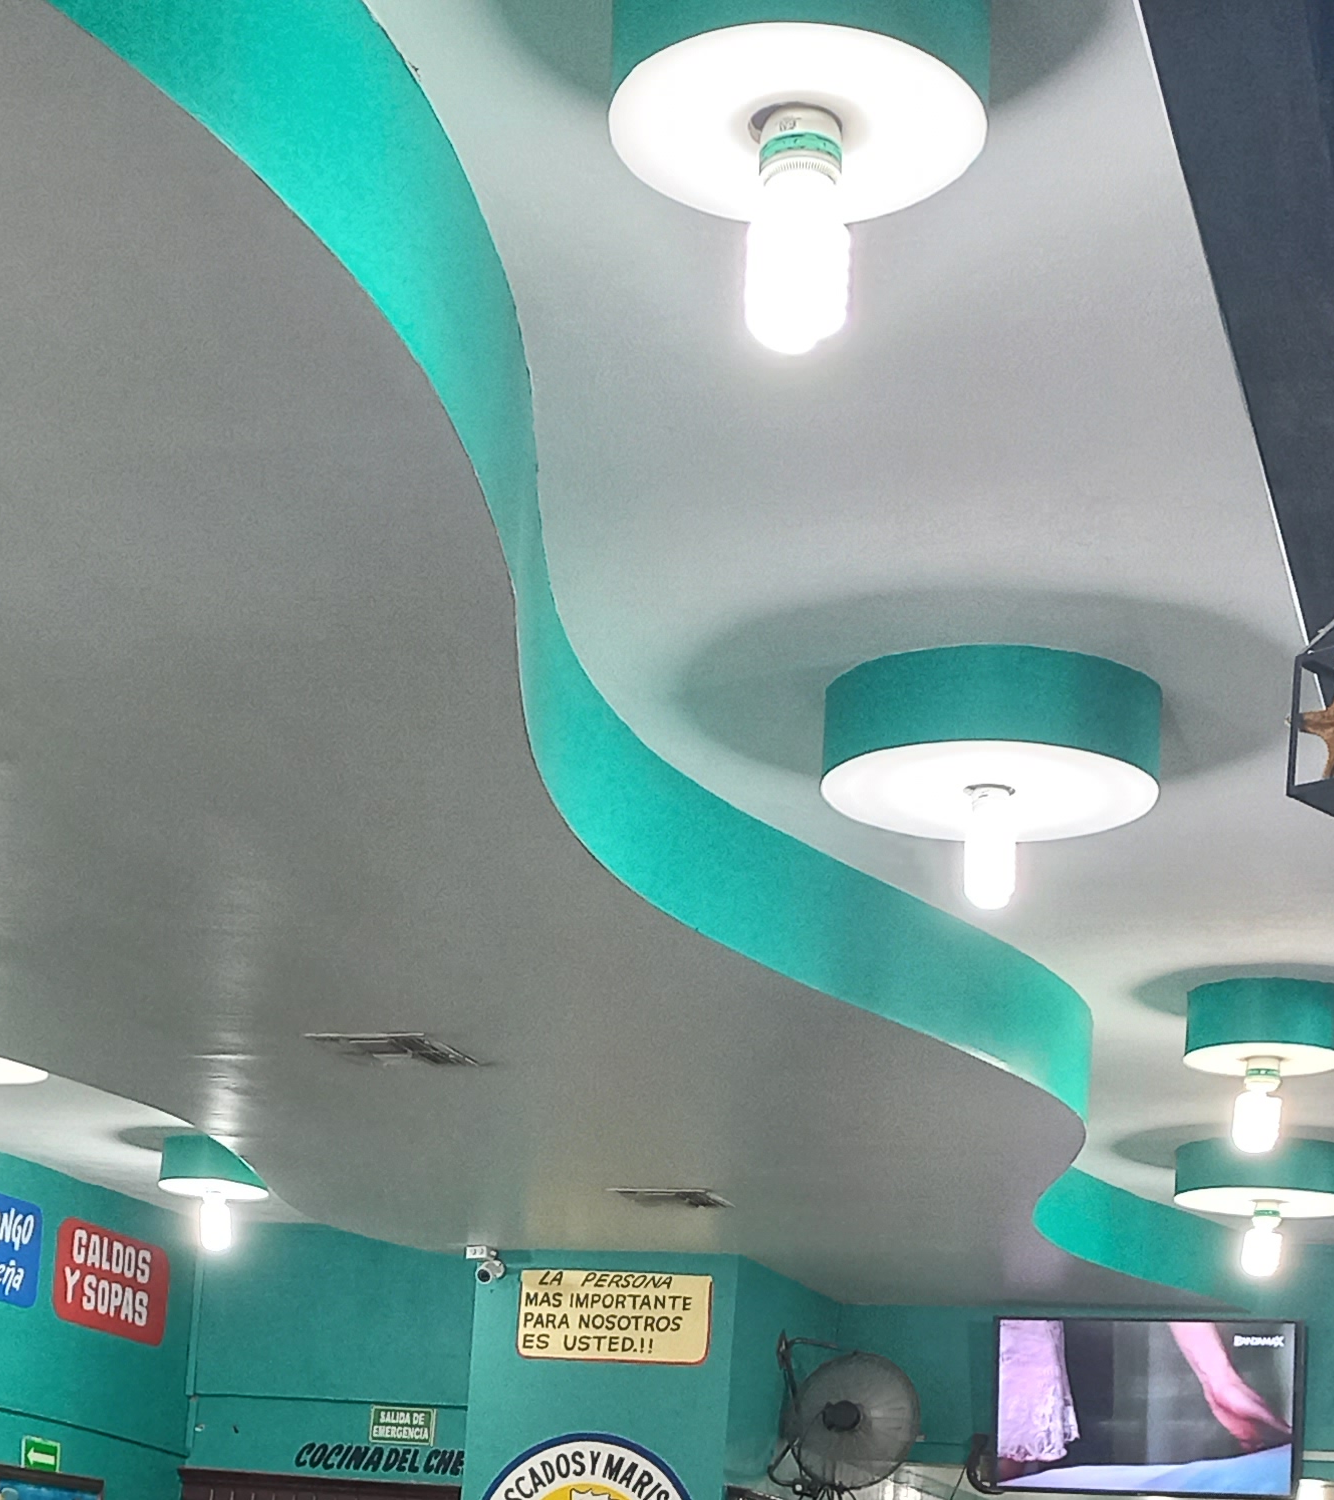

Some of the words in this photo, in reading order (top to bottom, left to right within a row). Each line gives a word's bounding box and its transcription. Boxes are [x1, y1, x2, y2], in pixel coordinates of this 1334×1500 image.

[73, 1228, 152, 1284] CALDOS
[538, 1270, 564, 1286] LA
[581, 1272, 673, 1289] PERSONA
[64, 1265, 81, 1304] Y
[81, 1273, 150, 1327] SOPAS
[524, 1291, 564, 1308] MAS
[569, 1293, 693, 1311] IMPORTANTE
[523, 1312, 570, 1330] PARA
[578, 1314, 684, 1332] NOSOTROS
[522, 1333, 550, 1349] ES
[379, 1411, 411, 1425] SALIDA
[412, 1413, 426, 1425] DE
[373, 1425, 429, 1440] EMERGENCIA
[294, 1442, 384, 1473] COCINA
[382, 1446, 420, 1473] DEL
[423, 1448, 465, 1477] CHE
[587, 1450, 601, 1475] Y
